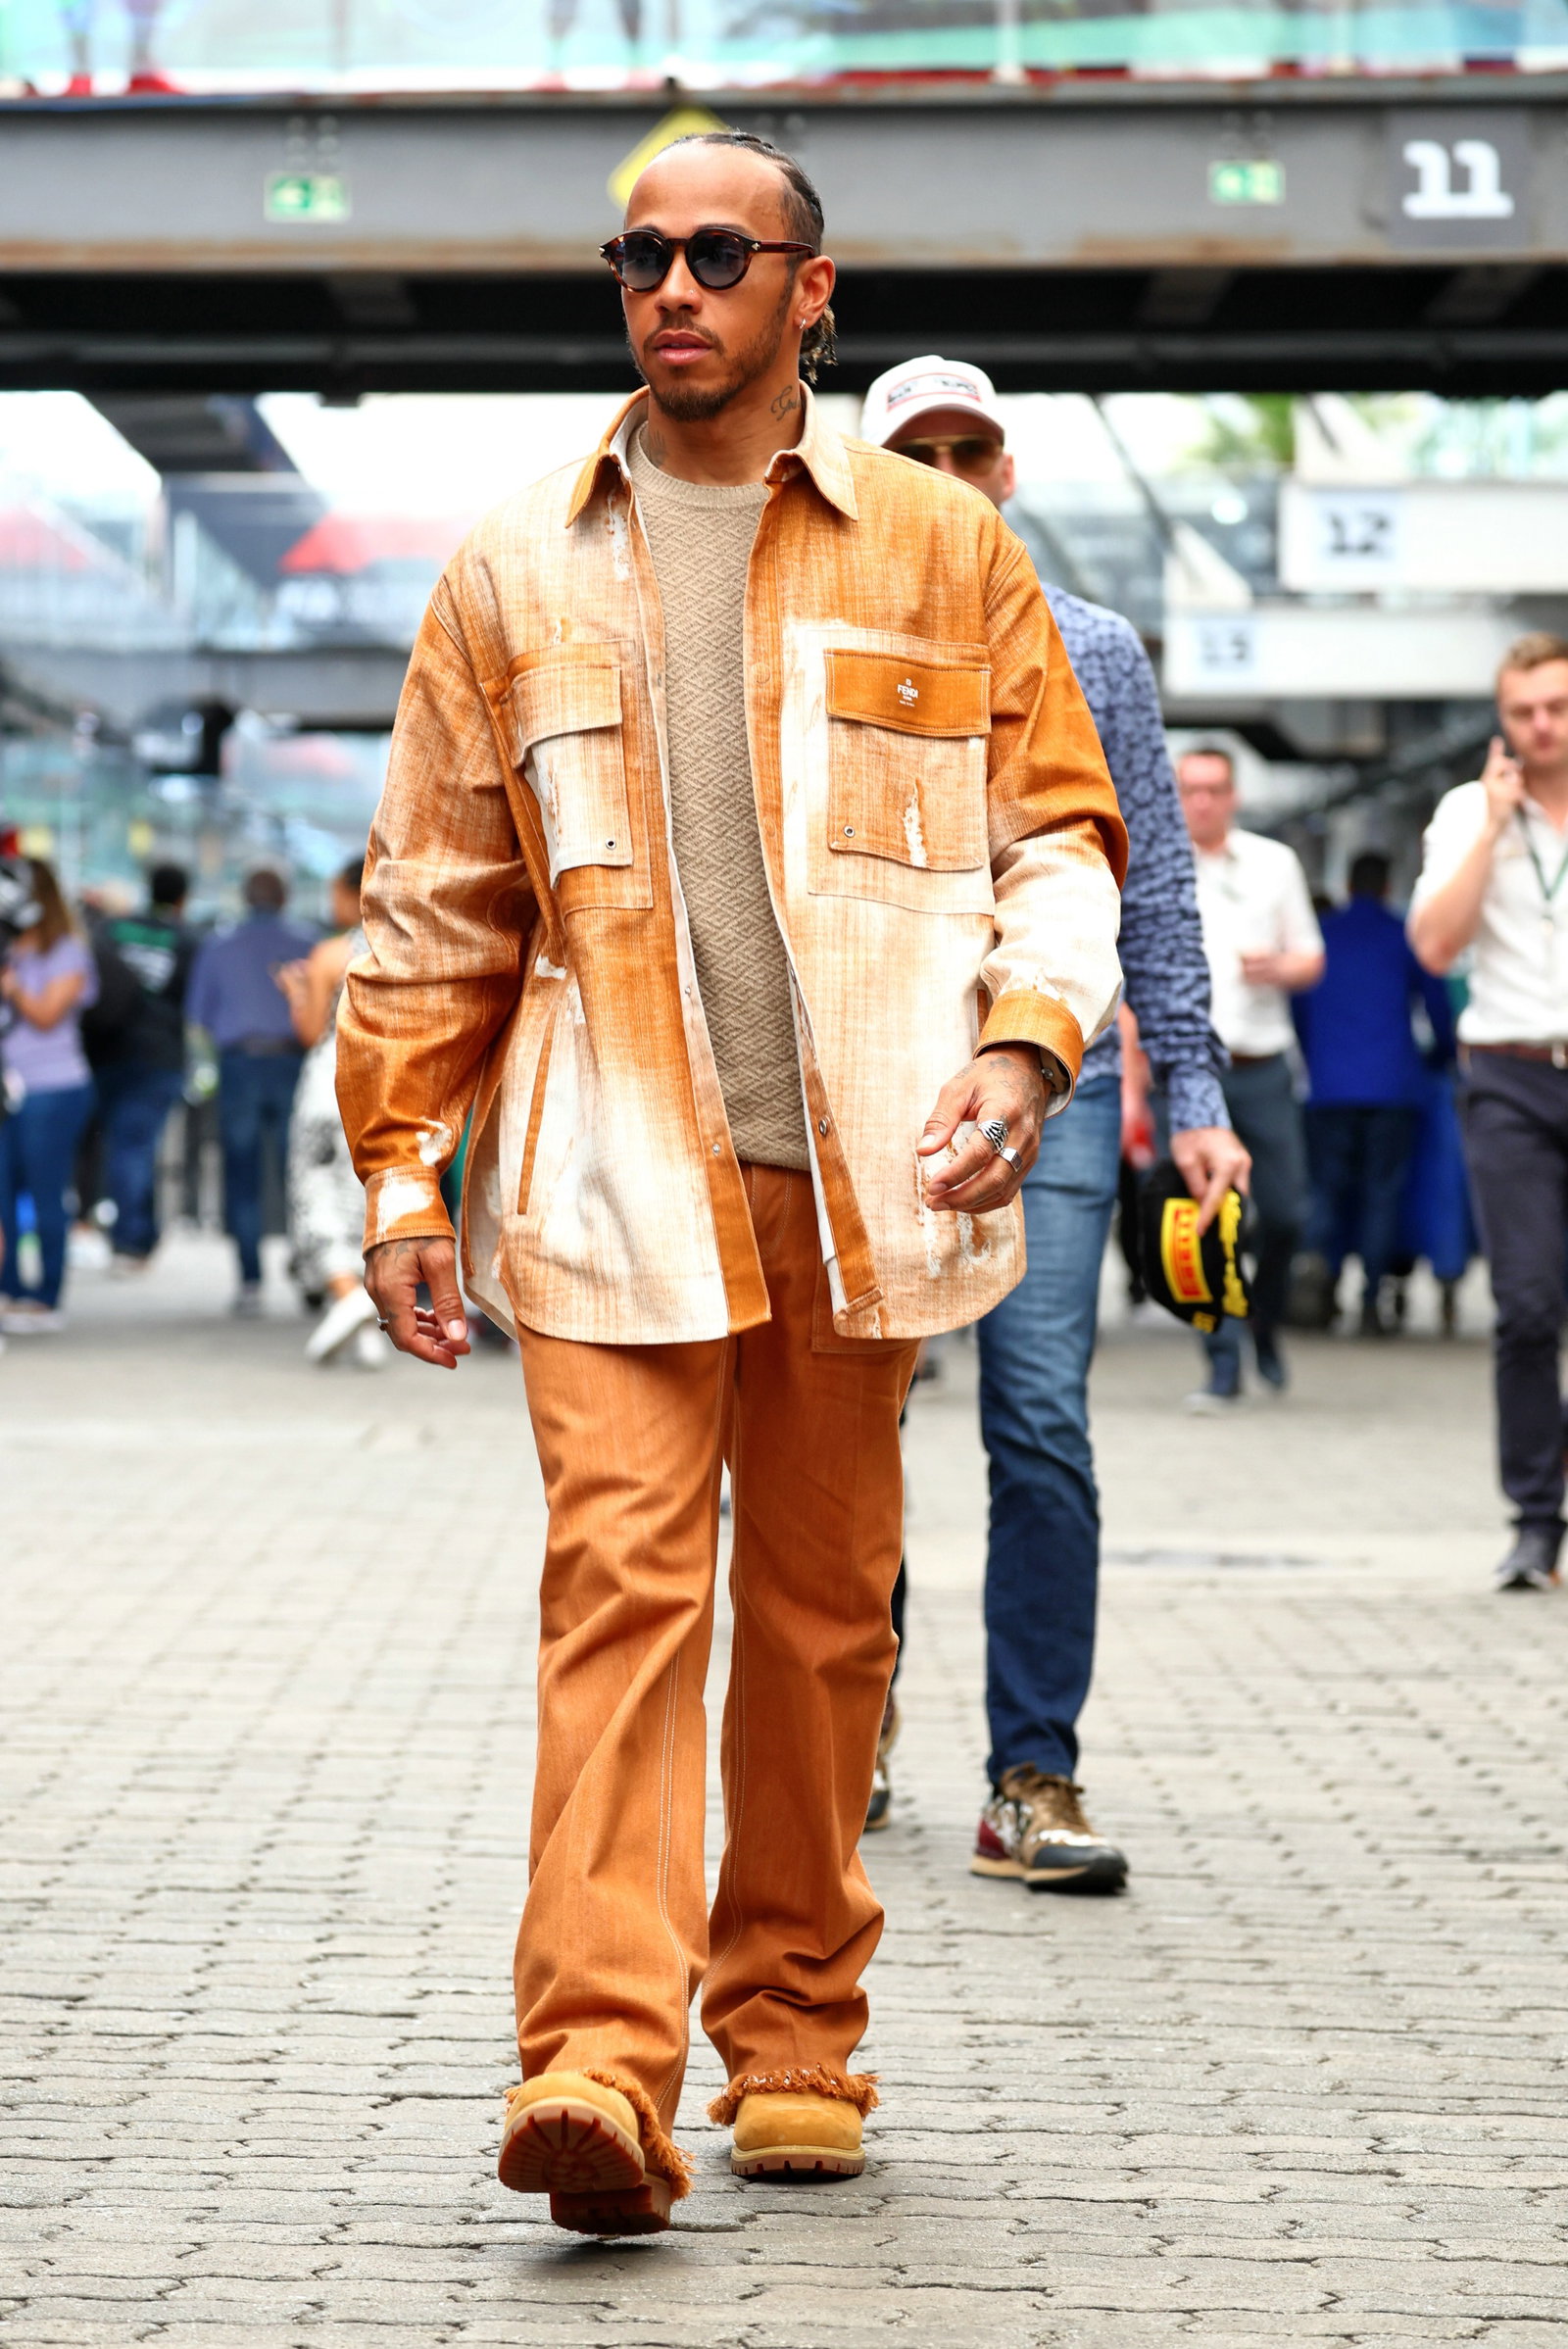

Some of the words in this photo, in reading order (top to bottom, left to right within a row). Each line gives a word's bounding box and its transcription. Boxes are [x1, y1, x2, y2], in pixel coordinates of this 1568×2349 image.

[1402, 139, 1515, 219] 11
[1328, 510, 1392, 555] 12
[897, 684, 918, 699] FENDI
